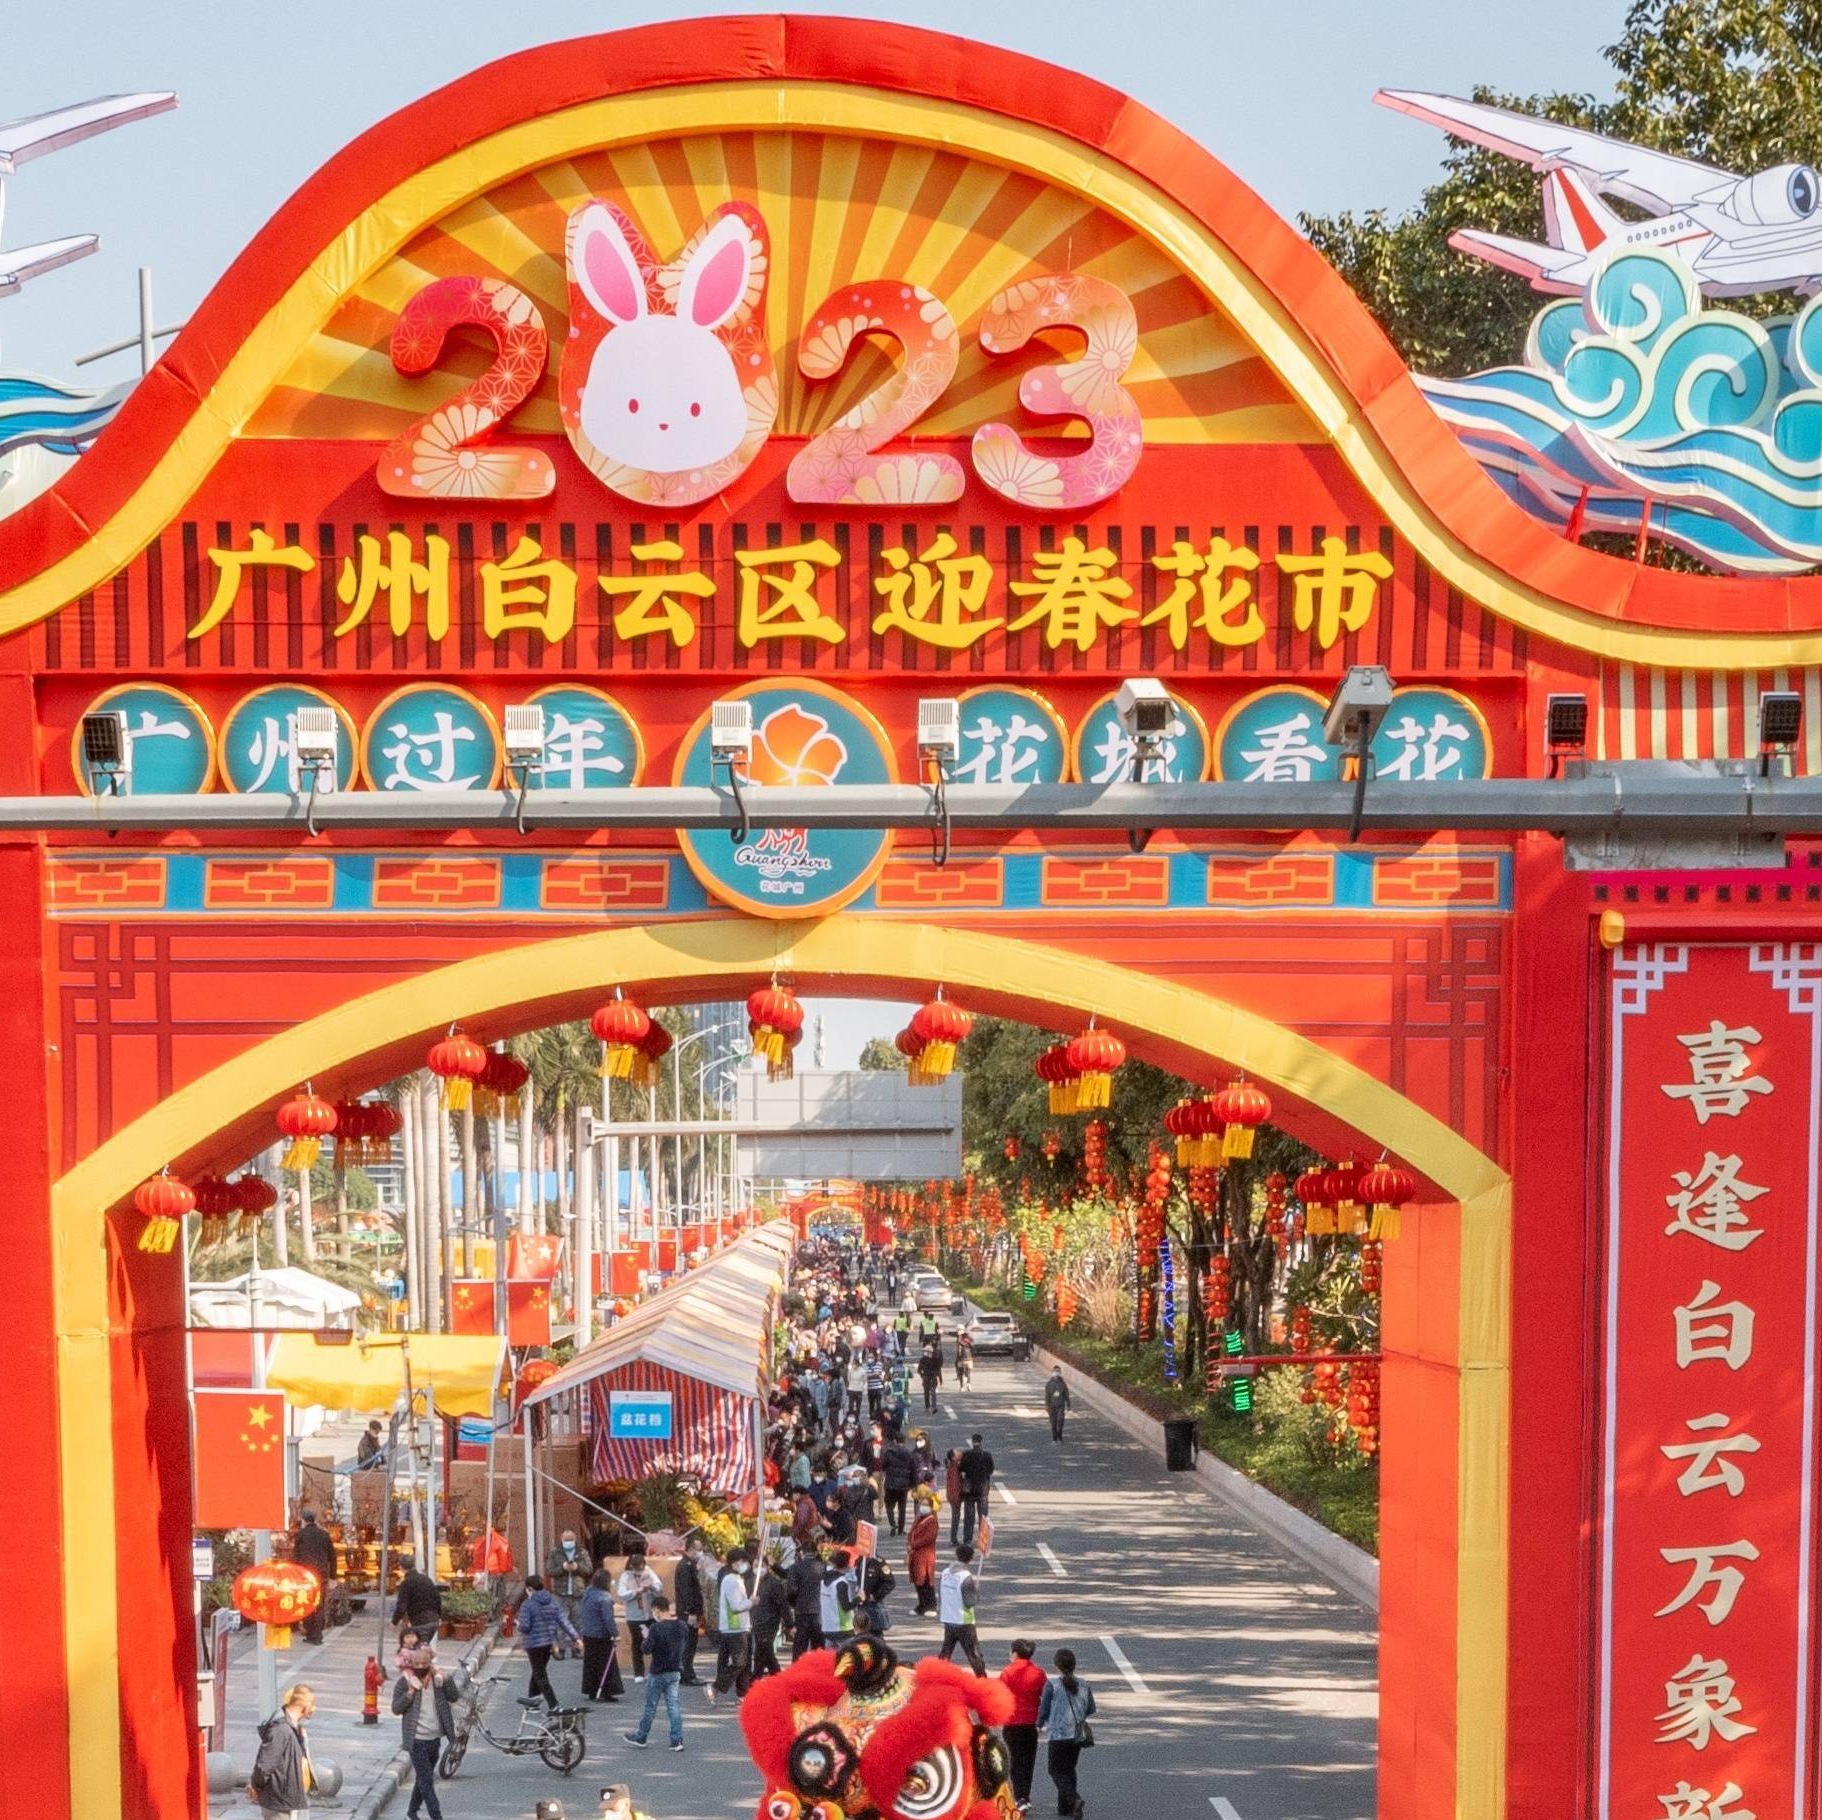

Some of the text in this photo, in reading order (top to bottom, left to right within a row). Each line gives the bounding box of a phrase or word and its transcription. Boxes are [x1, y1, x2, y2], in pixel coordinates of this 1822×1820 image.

[186, 529, 1394, 653] 广州白云区迎春花市
